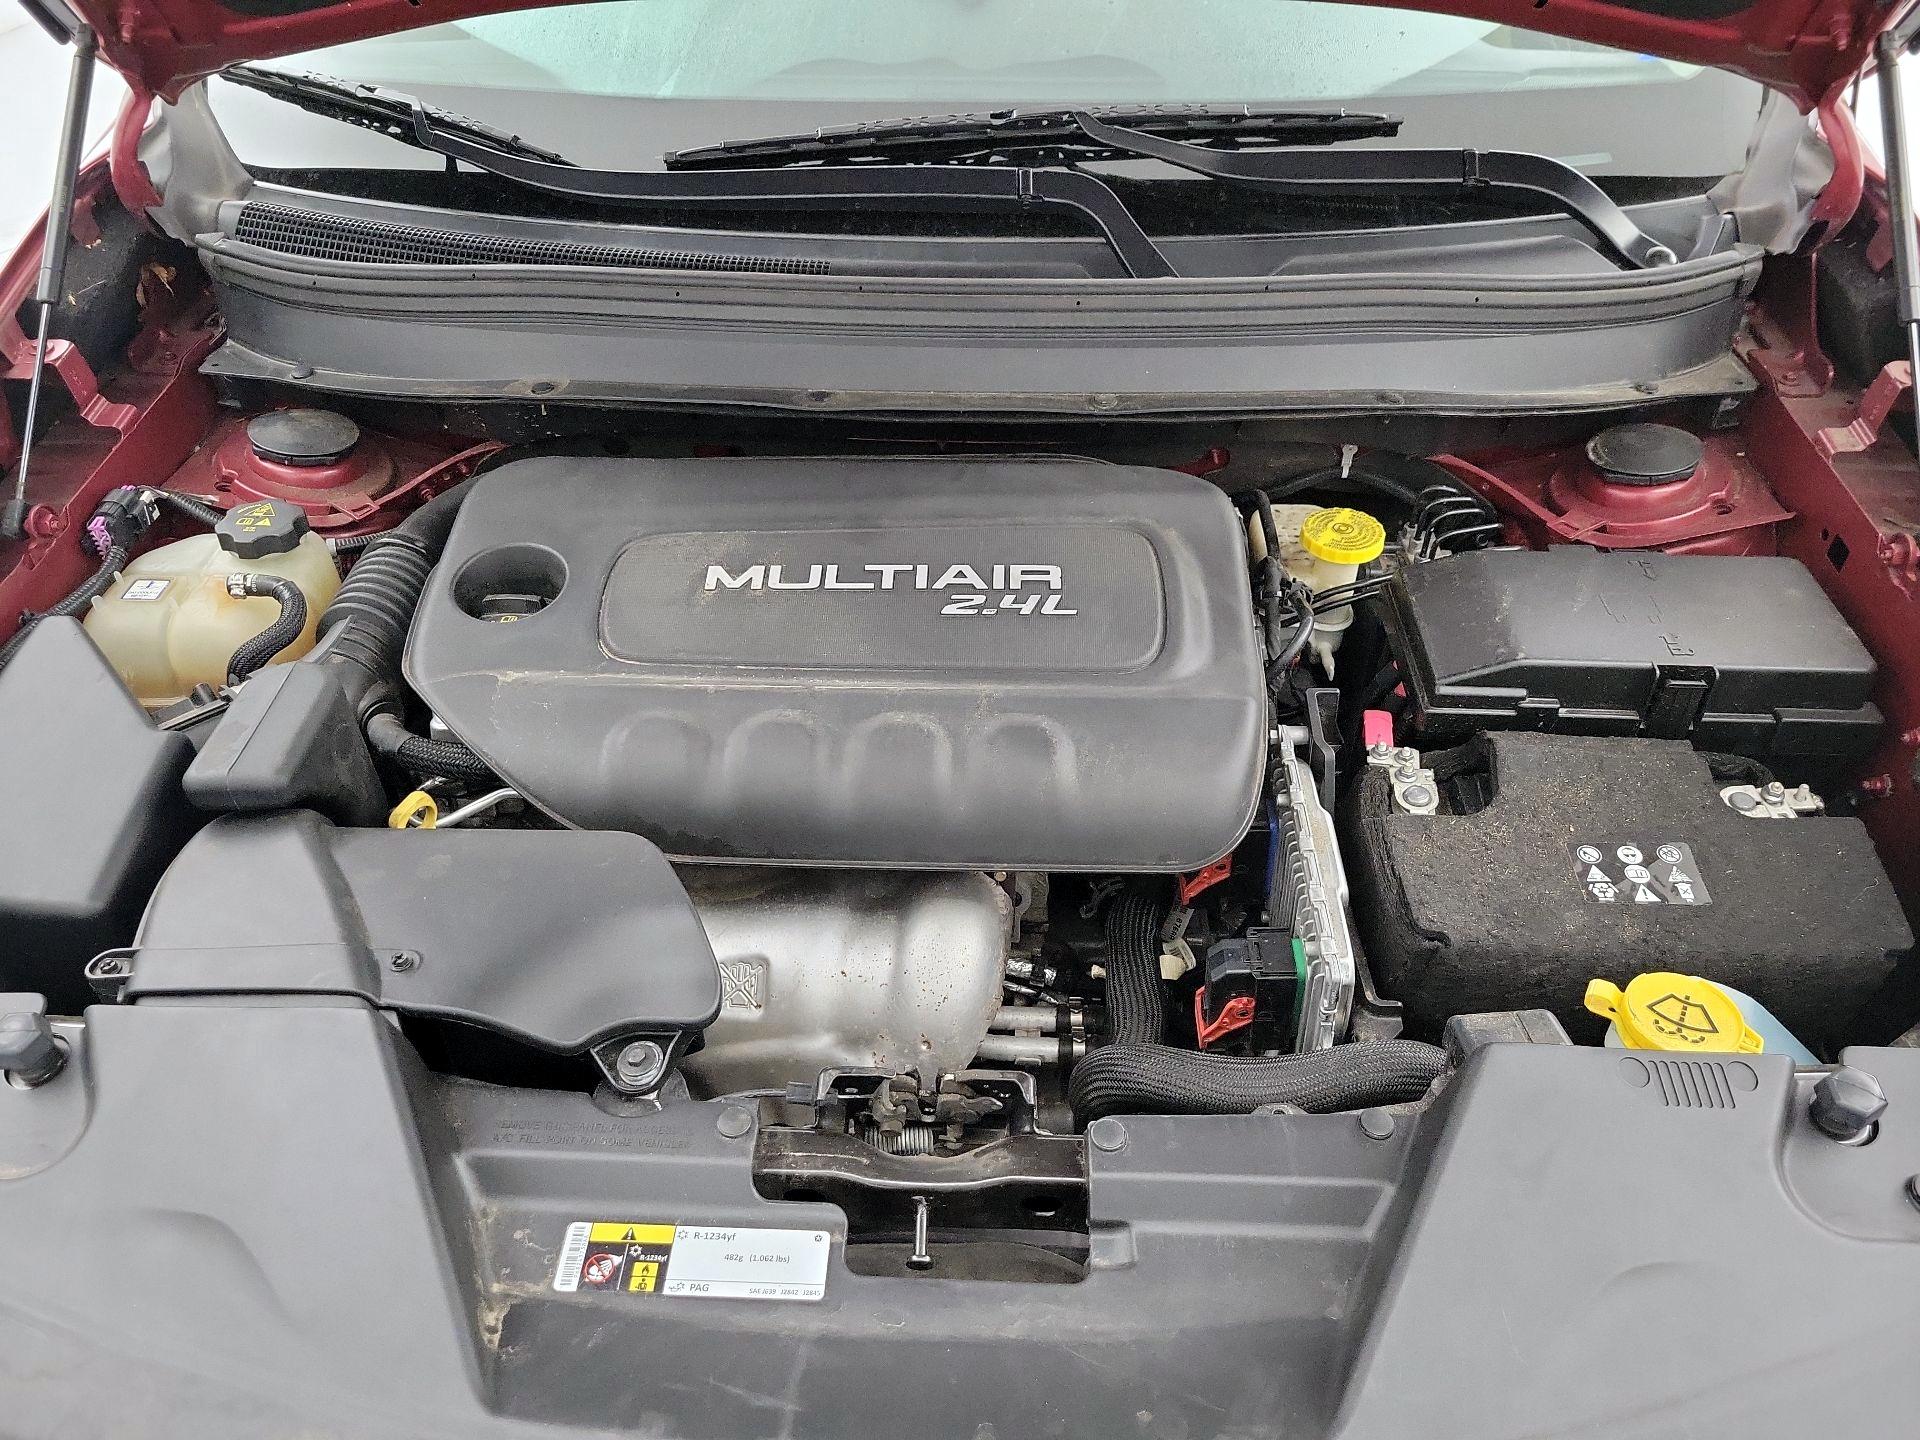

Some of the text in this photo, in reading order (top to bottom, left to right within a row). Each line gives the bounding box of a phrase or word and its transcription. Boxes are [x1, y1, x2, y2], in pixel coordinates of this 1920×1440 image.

[704, 563, 1063, 590] MULTIAIR
[939, 594, 1078, 616] 2.4L
[693, 1232, 737, 1242] R-1234yf
[724, 1254, 790, 1264] 482g (1.062 lbs)
[689, 1283, 710, 1292] PAG
